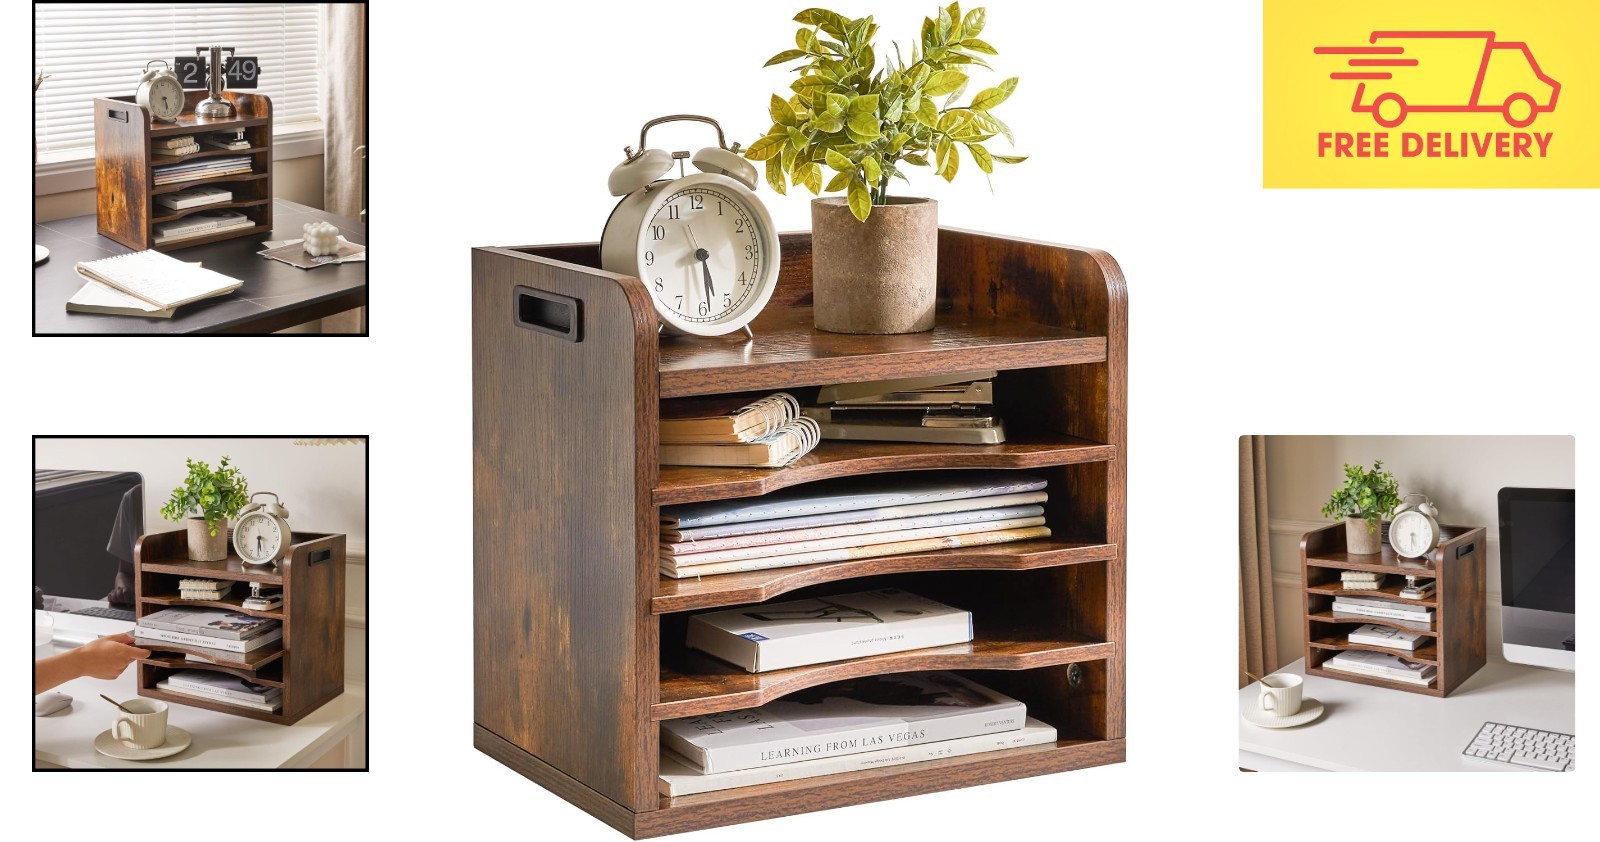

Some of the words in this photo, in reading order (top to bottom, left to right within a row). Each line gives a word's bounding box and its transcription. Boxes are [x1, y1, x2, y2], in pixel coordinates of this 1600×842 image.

[183, 62, 198, 83] 2
[227, 60, 257, 81] 49
[689, 195, 704, 210] 12
[717, 201, 724, 216] 1
[668, 205, 680, 220] 11
[652, 225, 665, 241] 10
[735, 218, 744, 233] 2
[645, 251, 654, 266] 9
[745, 245, 753, 260] 3
[654, 277, 664, 292] 8
[737, 271, 747, 286] 4
[675, 295, 684, 310] 7
[723, 293, 732, 308] 5
[698, 301, 708, 317] 6
[761, 743, 822, 761] LEARNING
[826, 739, 858, 753] FROM
[862, 732, 884, 747] LAS
[888, 729, 926, 743] VEGAS
